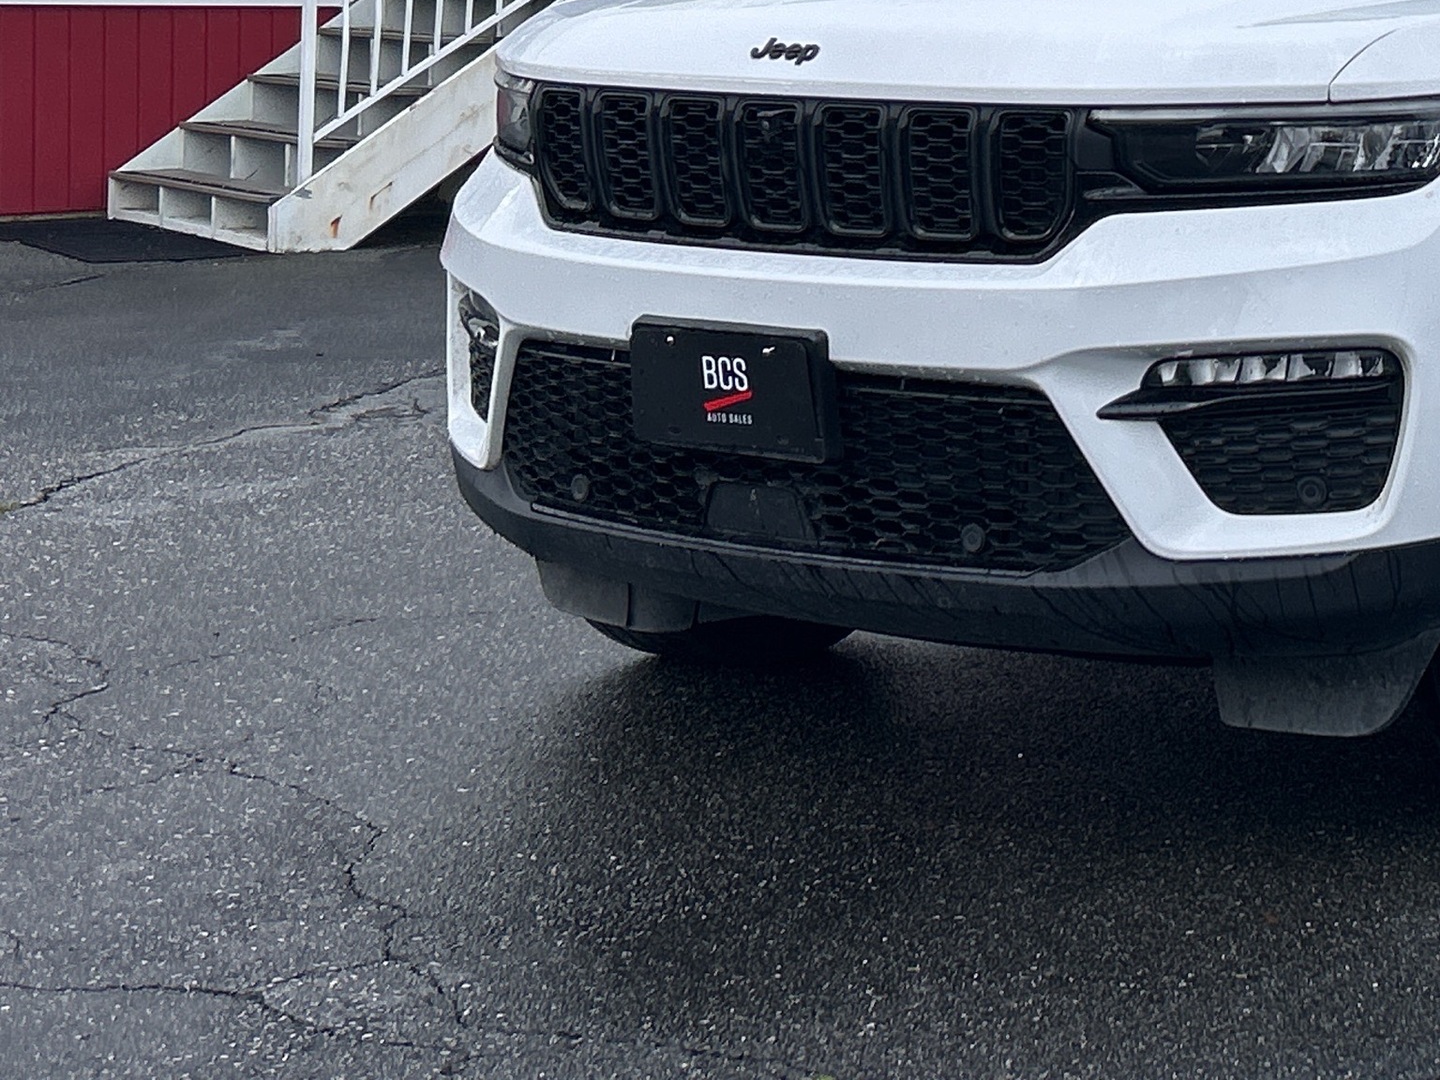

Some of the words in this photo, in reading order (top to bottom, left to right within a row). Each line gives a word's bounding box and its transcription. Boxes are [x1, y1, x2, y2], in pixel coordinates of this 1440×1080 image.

[750, 37, 820, 66] Jeep
[702, 355, 748, 392] BCS
[707, 412, 727, 423] AUTO
[729, 413, 752, 424] SALES
